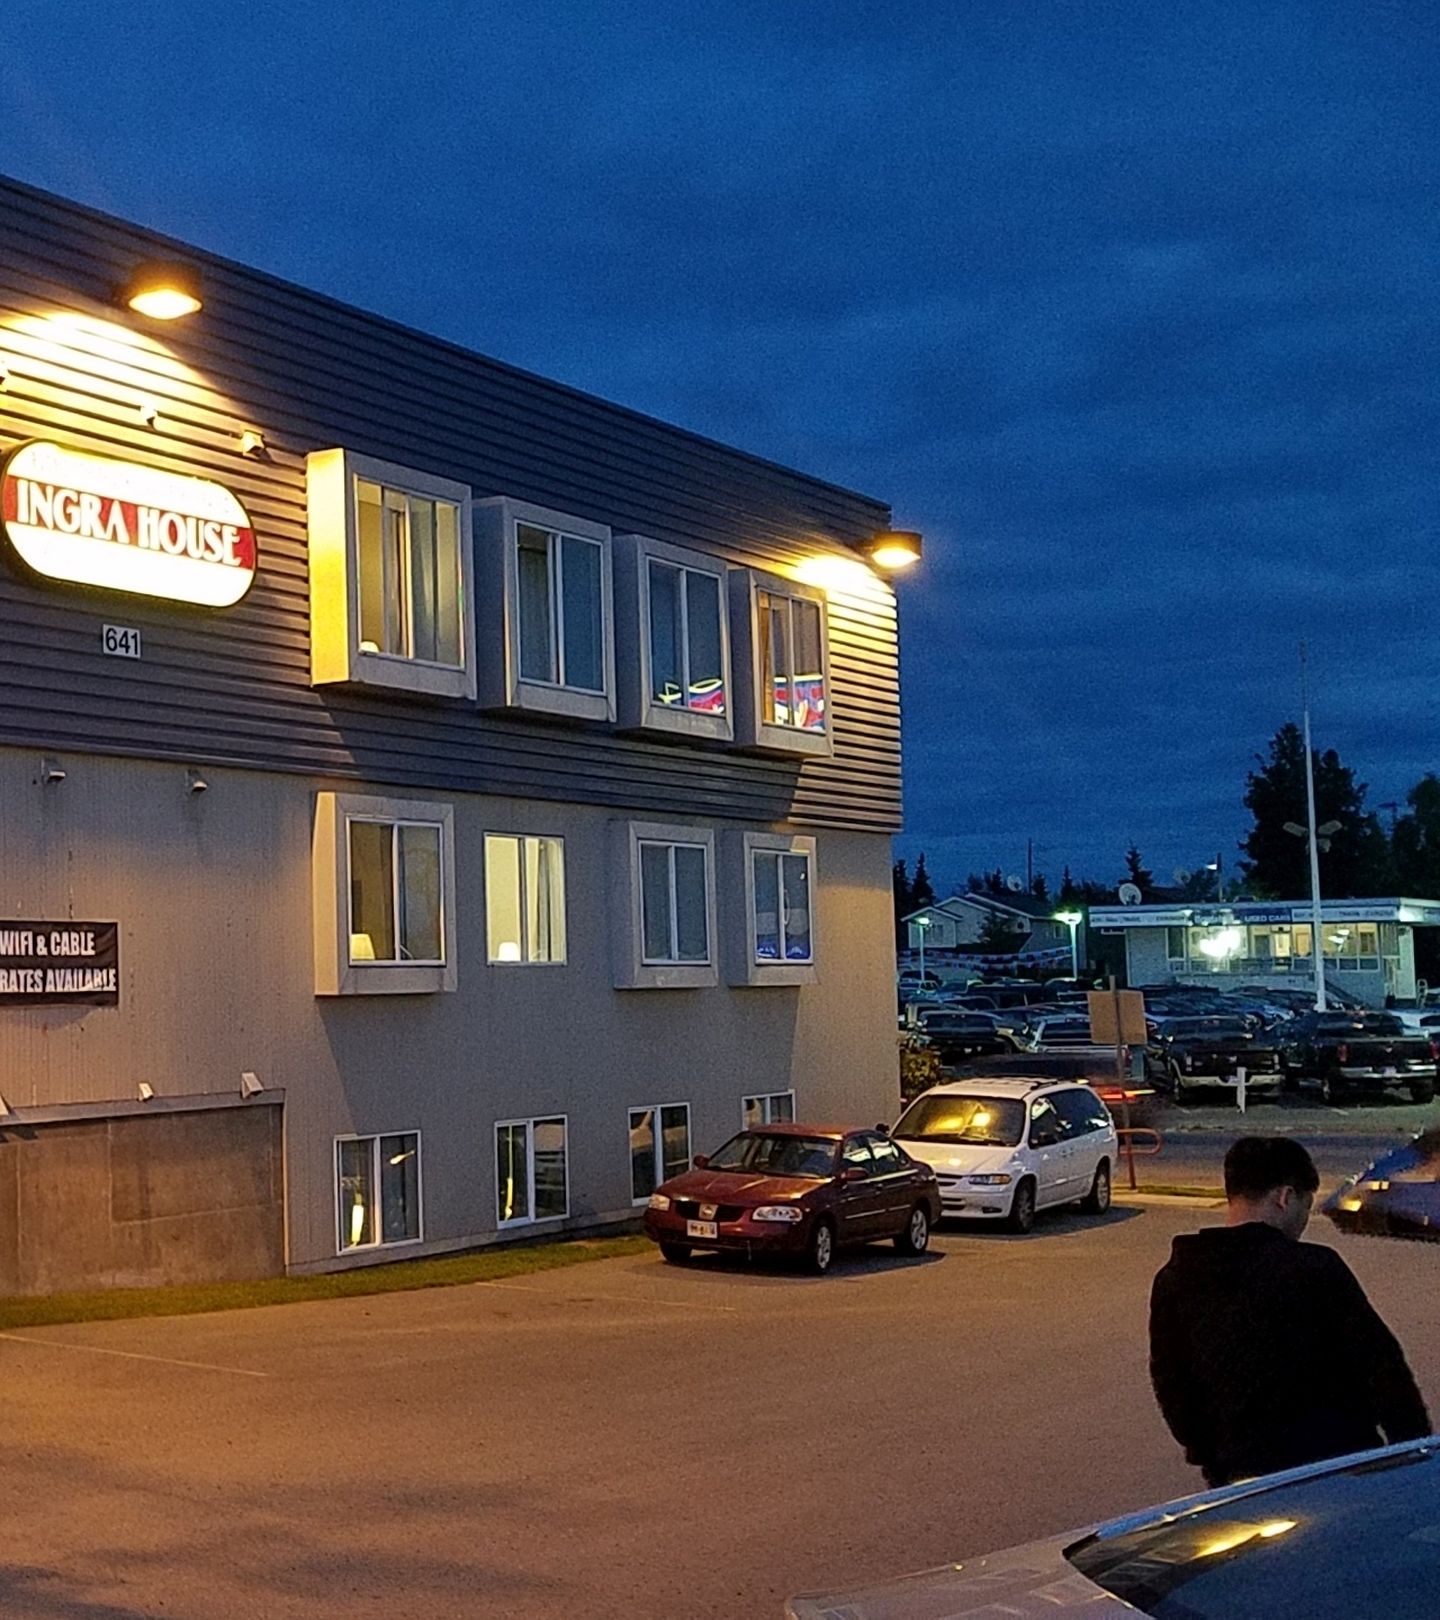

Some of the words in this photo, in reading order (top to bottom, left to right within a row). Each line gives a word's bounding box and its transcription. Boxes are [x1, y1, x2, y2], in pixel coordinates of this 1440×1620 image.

[16, 479, 130, 544] INGRA
[137, 506, 242, 566] HOUSE
[105, 628, 139, 655] 641
[36, 934, 48, 955] &
[50, 932, 95, 955] CABLE
[45, 968, 116, 993] AVAILABLE
